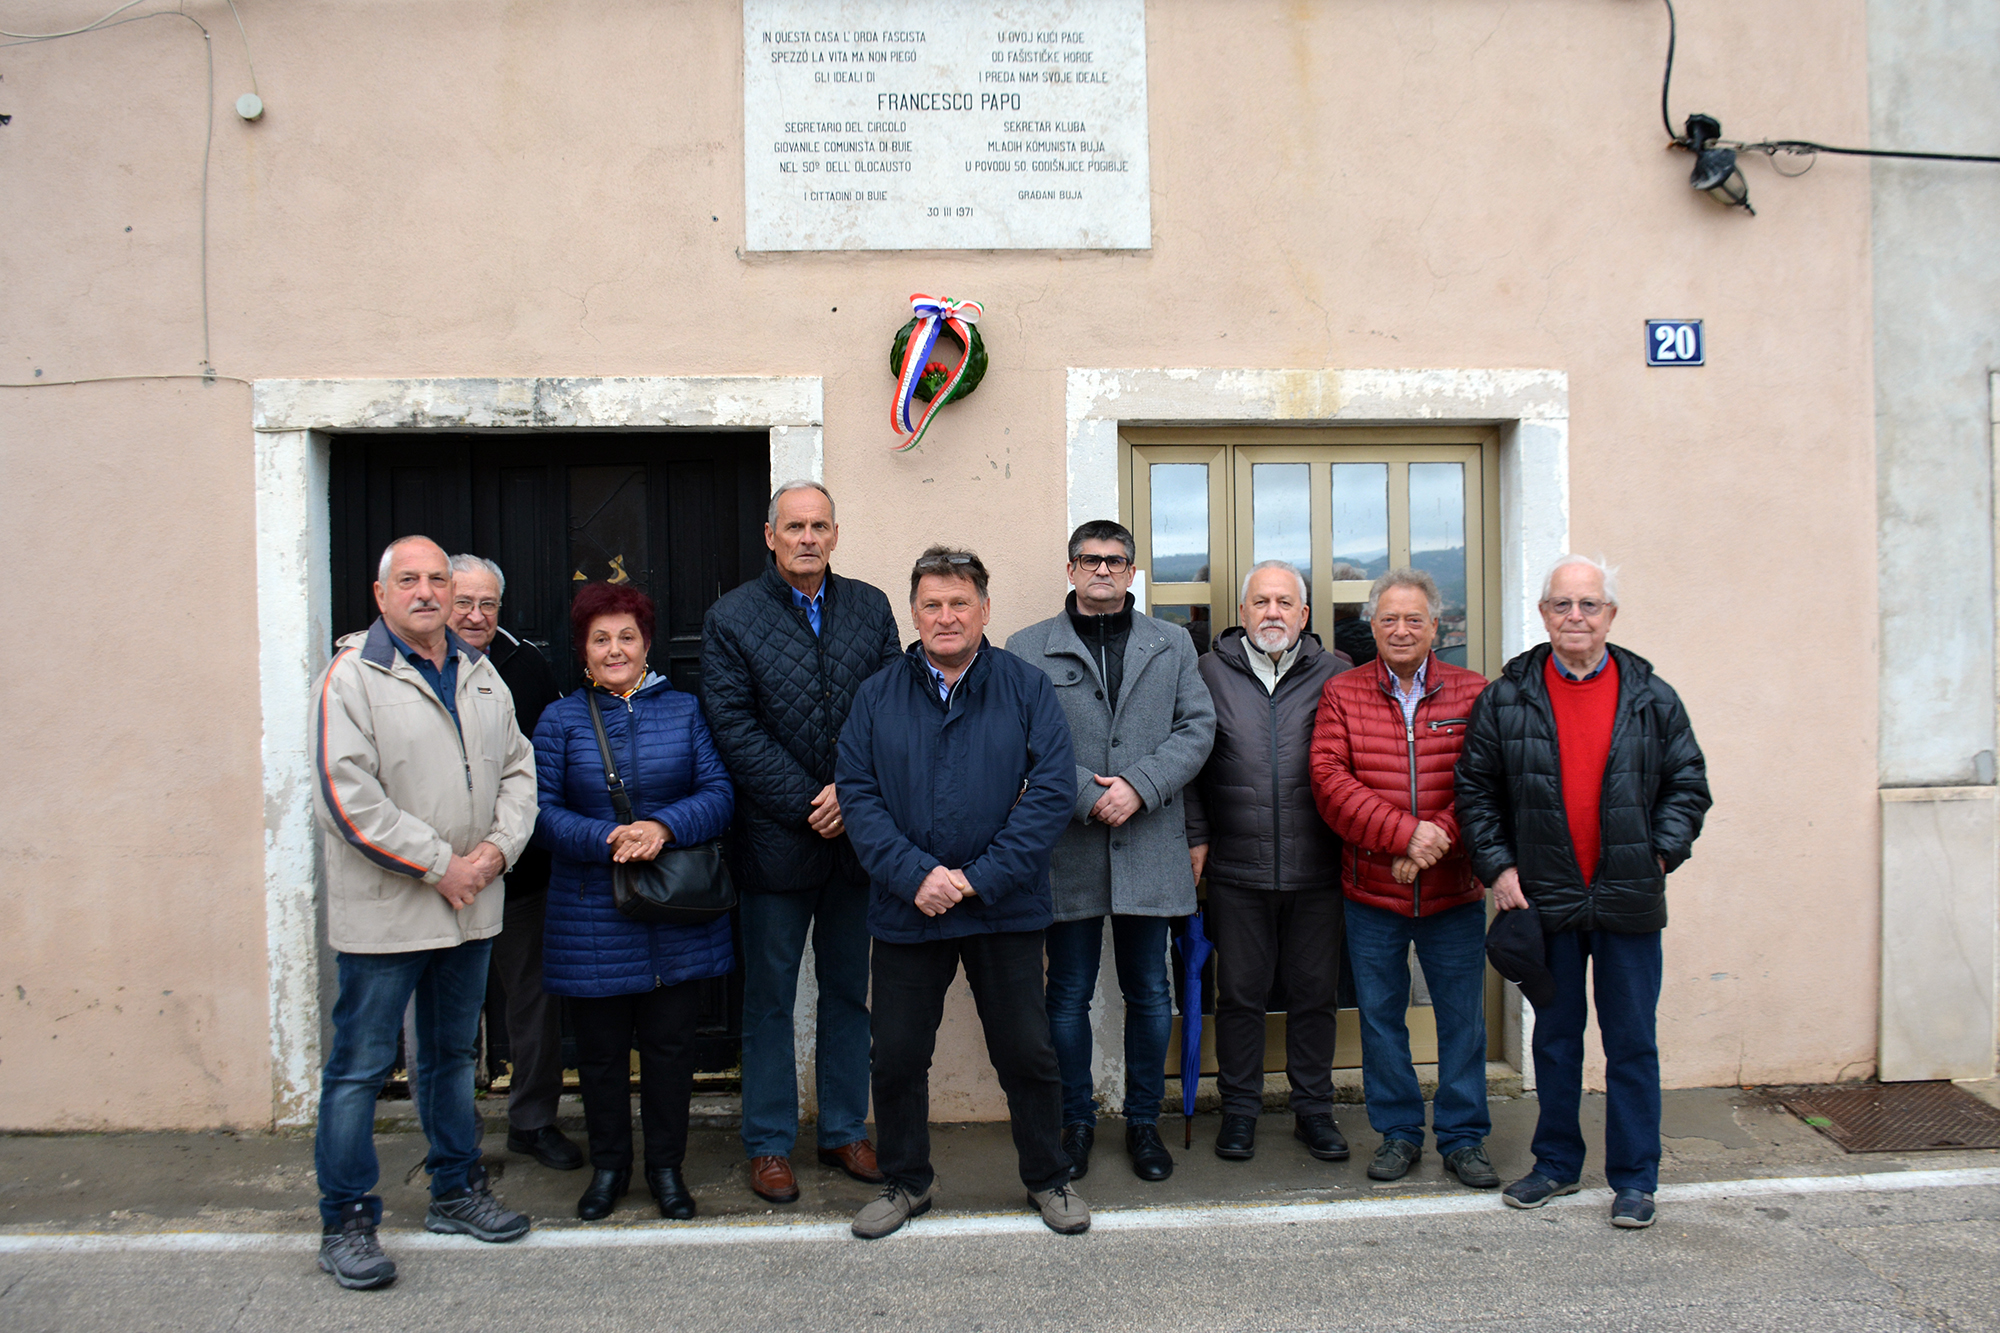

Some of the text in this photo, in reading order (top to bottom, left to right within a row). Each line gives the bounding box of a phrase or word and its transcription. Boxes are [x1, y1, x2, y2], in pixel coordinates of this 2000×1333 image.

[762, 31, 772, 43] IN
[774, 31, 811, 44] QUESTA
[814, 31, 839, 43] CASA
[882, 31, 926, 43] FASCISTA
[997, 30, 1085, 43] U OVOJ KUĆI PADE
[811, 51, 824, 62] LA
[828, 51, 848, 62] VITA
[851, 51, 865, 62] MA
[868, 51, 887, 62] NON
[991, 48, 1094, 63] OD FAŠISTIČKE HORDE
[814, 71, 876, 83] GLI IDEALI DI
[985, 71, 1016, 83] PREDA
[1019, 71, 1039, 83] NAM
[1042, 71, 1073, 83] SVOJE
[1075, 71, 1109, 83] IDEALE
[878, 93, 1021, 111] FRANCESCO PAPO
[784, 121, 907, 133] SEGRETARIO DEL CIRCOLO
[1003, 121, 1087, 133] SEKRETAR KLUBA
[774, 141, 913, 153] GIOVANILE COMUNISTA DI BUIE
[987, 141, 1106, 152] MLADIH KOMUNISTA BUJA
[779, 161, 798, 173] NEL
[965, 161, 972, 172] U
[974, 161, 1011, 172] POVODU
[1031, 158, 1085, 172] GODIŠNJICE
[1087, 161, 1129, 172] POGIBIJE
[810, 191, 852, 201] CITTADINI
[855, 191, 864, 201] DI
[867, 191, 888, 201] BUIE
[1059, 190, 1083, 200] BUJA
[927, 206, 974, 217] 30 III 1971
[1654, 325, 1697, 360] 20
